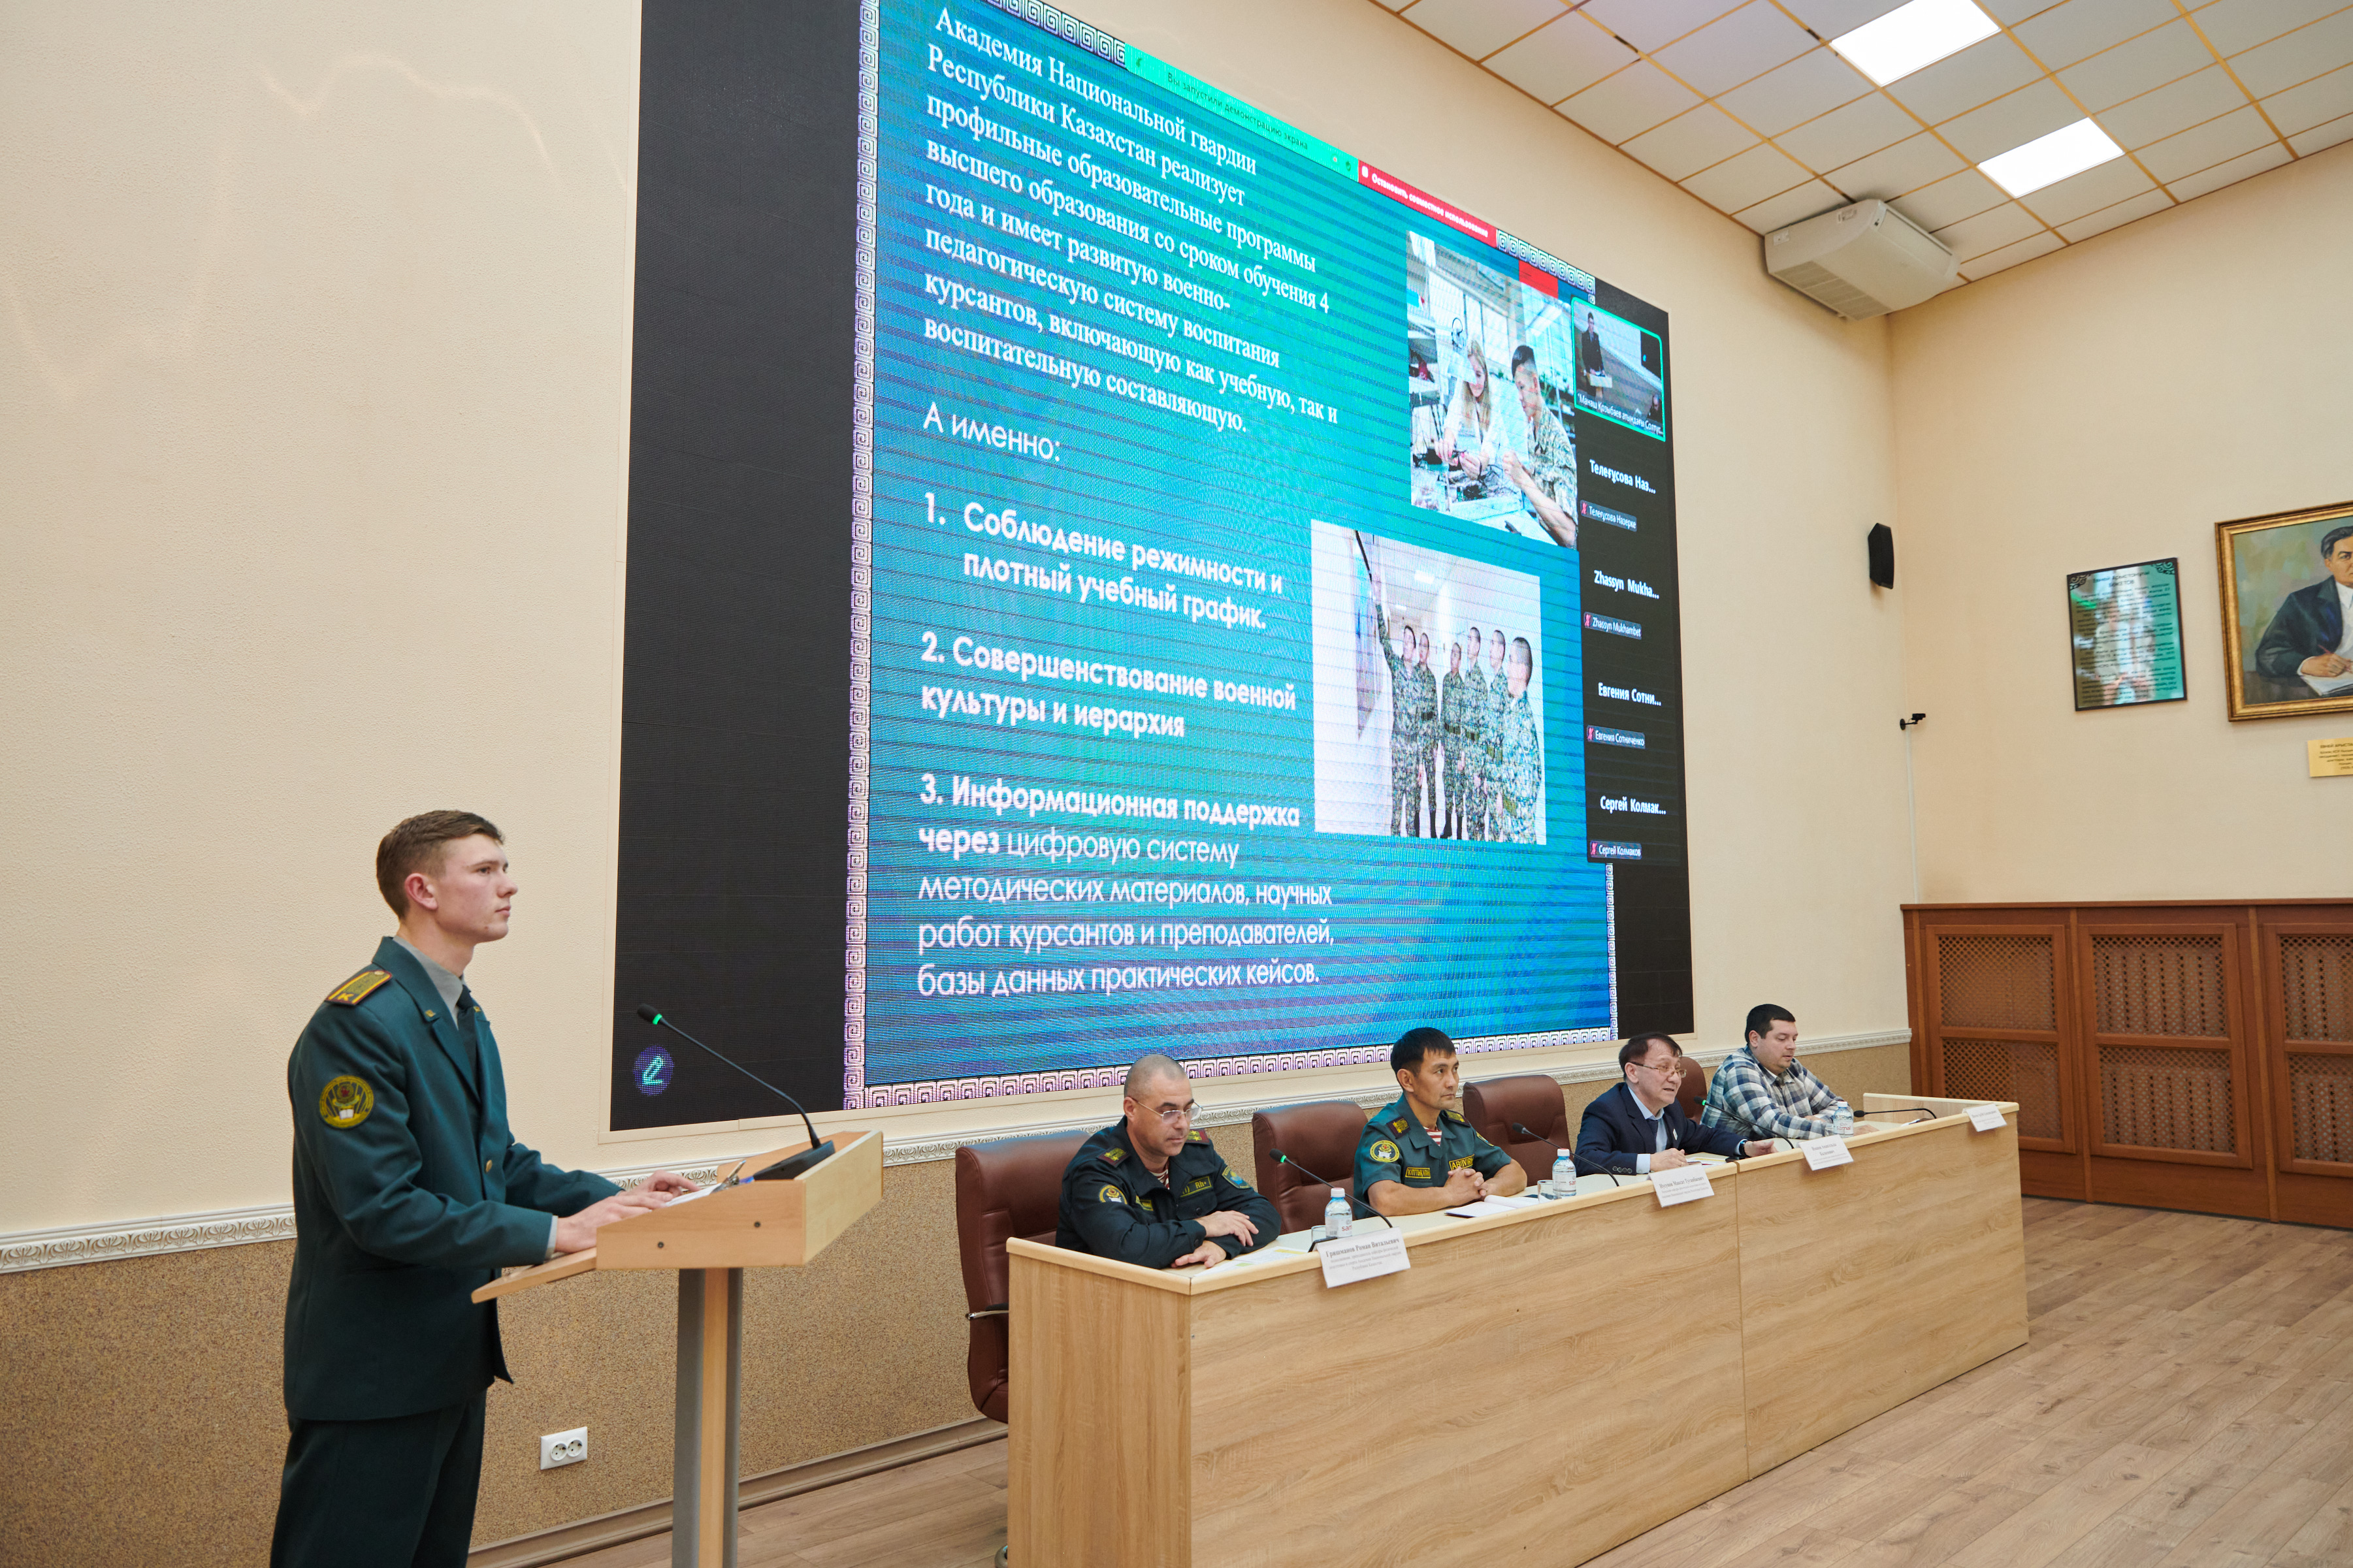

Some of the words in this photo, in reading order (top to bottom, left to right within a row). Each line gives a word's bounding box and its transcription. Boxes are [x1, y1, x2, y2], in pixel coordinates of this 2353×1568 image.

[936, 8, 1041, 76] Академия
[1049, 57, 1184, 142] Национальной
[1191, 131, 1256, 174] гвардии
[1168, 72, 1180, 87] Вы
[1182, 83, 1222, 108] запустили
[1225, 104, 1282, 137] демонстрацию
[1284, 132, 1308, 150] экрана
[928, 44, 1054, 123] Республики
[1062, 103, 1156, 167] Казахстан
[1161, 155, 1244, 205] реализует
[928, 96, 1062, 166] профильные
[1067, 153, 1222, 233] образовательные
[1227, 221, 1315, 272] программы
[1372, 173, 1408, 199] Остановить
[1408, 193, 1444, 216] совместное
[1444, 210, 1488, 238] использование
[926, 184, 975, 218] года
[982, 204, 994, 227] и
[1001, 212, 1062, 250] имеет
[1067, 238, 1158, 285] развитую
[1163, 273, 1230, 309] военно-
[927, 140, 1023, 193] высшего
[1028, 179, 1148, 243] образования
[1154, 232, 1175, 251] со
[1179, 242, 1239, 279] сроком
[1243, 264, 1316, 308] обучения
[1320, 293, 1329, 313] 4
[926, 228, 1098, 304] педагогическую
[1103, 293, 1178, 338] систему
[1184, 319, 1279, 368] воспитания
[924, 318, 1101, 389] воспитательную
[1105, 374, 1246, 432] составляющую.
[925, 273, 1043, 332] курсантов,
[1049, 314, 1181, 373] включающую
[1186, 359, 1214, 384] как
[1218, 370, 1295, 412] учебную,
[1299, 397, 1323, 419] так
[1327, 406, 1337, 423] и
[923, 402, 943, 433] А
[952, 414, 1060, 462] именно:
[1634, 475, 1656, 494] Наз...
[925, 491, 946, 525] 1.
[964, 502, 1126, 562] Соблюдение
[1131, 543, 1266, 592] режимности
[1270, 573, 1283, 594] и
[1616, 515, 1636, 530] Назерке
[964, 552, 1072, 594] плотный
[1077, 574, 1177, 613] учебный
[1182, 592, 1266, 630] график.
[1594, 569, 1625, 592] Zhassyn
[1627, 579, 1659, 600] Mukha...
[1592, 617, 1612, 633] Zhassyn
[1612, 622, 1641, 637] Mukhambet
[920, 630, 945, 663] 2.
[952, 635, 1208, 699] Совершенствование
[1212, 679, 1296, 711] военной
[1598, 682, 1630, 701] Евгения
[1631, 688, 1662, 707] Сотни...
[921, 684, 1046, 726] культуры
[1052, 701, 1067, 724] и
[1073, 703, 1185, 739] иерархия
[1595, 729, 1615, 743] Евгения
[1615, 733, 1645, 746] Сотниченко
[920, 772, 943, 805] 3.
[952, 775, 1178, 819] Информационная
[1183, 799, 1301, 831] поддержка
[1600, 795, 1628, 814] Сергей
[1630, 798, 1666, 815] Колмак...
[918, 827, 1001, 861] через
[1006, 826, 1141, 865] цифровую
[1146, 839, 1239, 869] систему
[1598, 844, 1616, 857] Сергей
[1617, 846, 1641, 857] Колмаков
[917, 875, 1104, 904] методических
[1109, 880, 1250, 909] материалов,
[1256, 884, 1332, 911] научных
[918, 914, 1003, 955] работ
[1009, 922, 1135, 955] курсантов
[1140, 923, 1155, 945] и
[1160, 918, 1334, 952] преподавателей,
[917, 963, 985, 997] базы
[990, 967, 1086, 997] данных
[1091, 963, 1242, 997] практических
[1246, 957, 1320, 985] кейсов.
[1325, 1247, 1355, 1258] Гришманов
[1371, 1238, 1399, 1248] Витальевич
